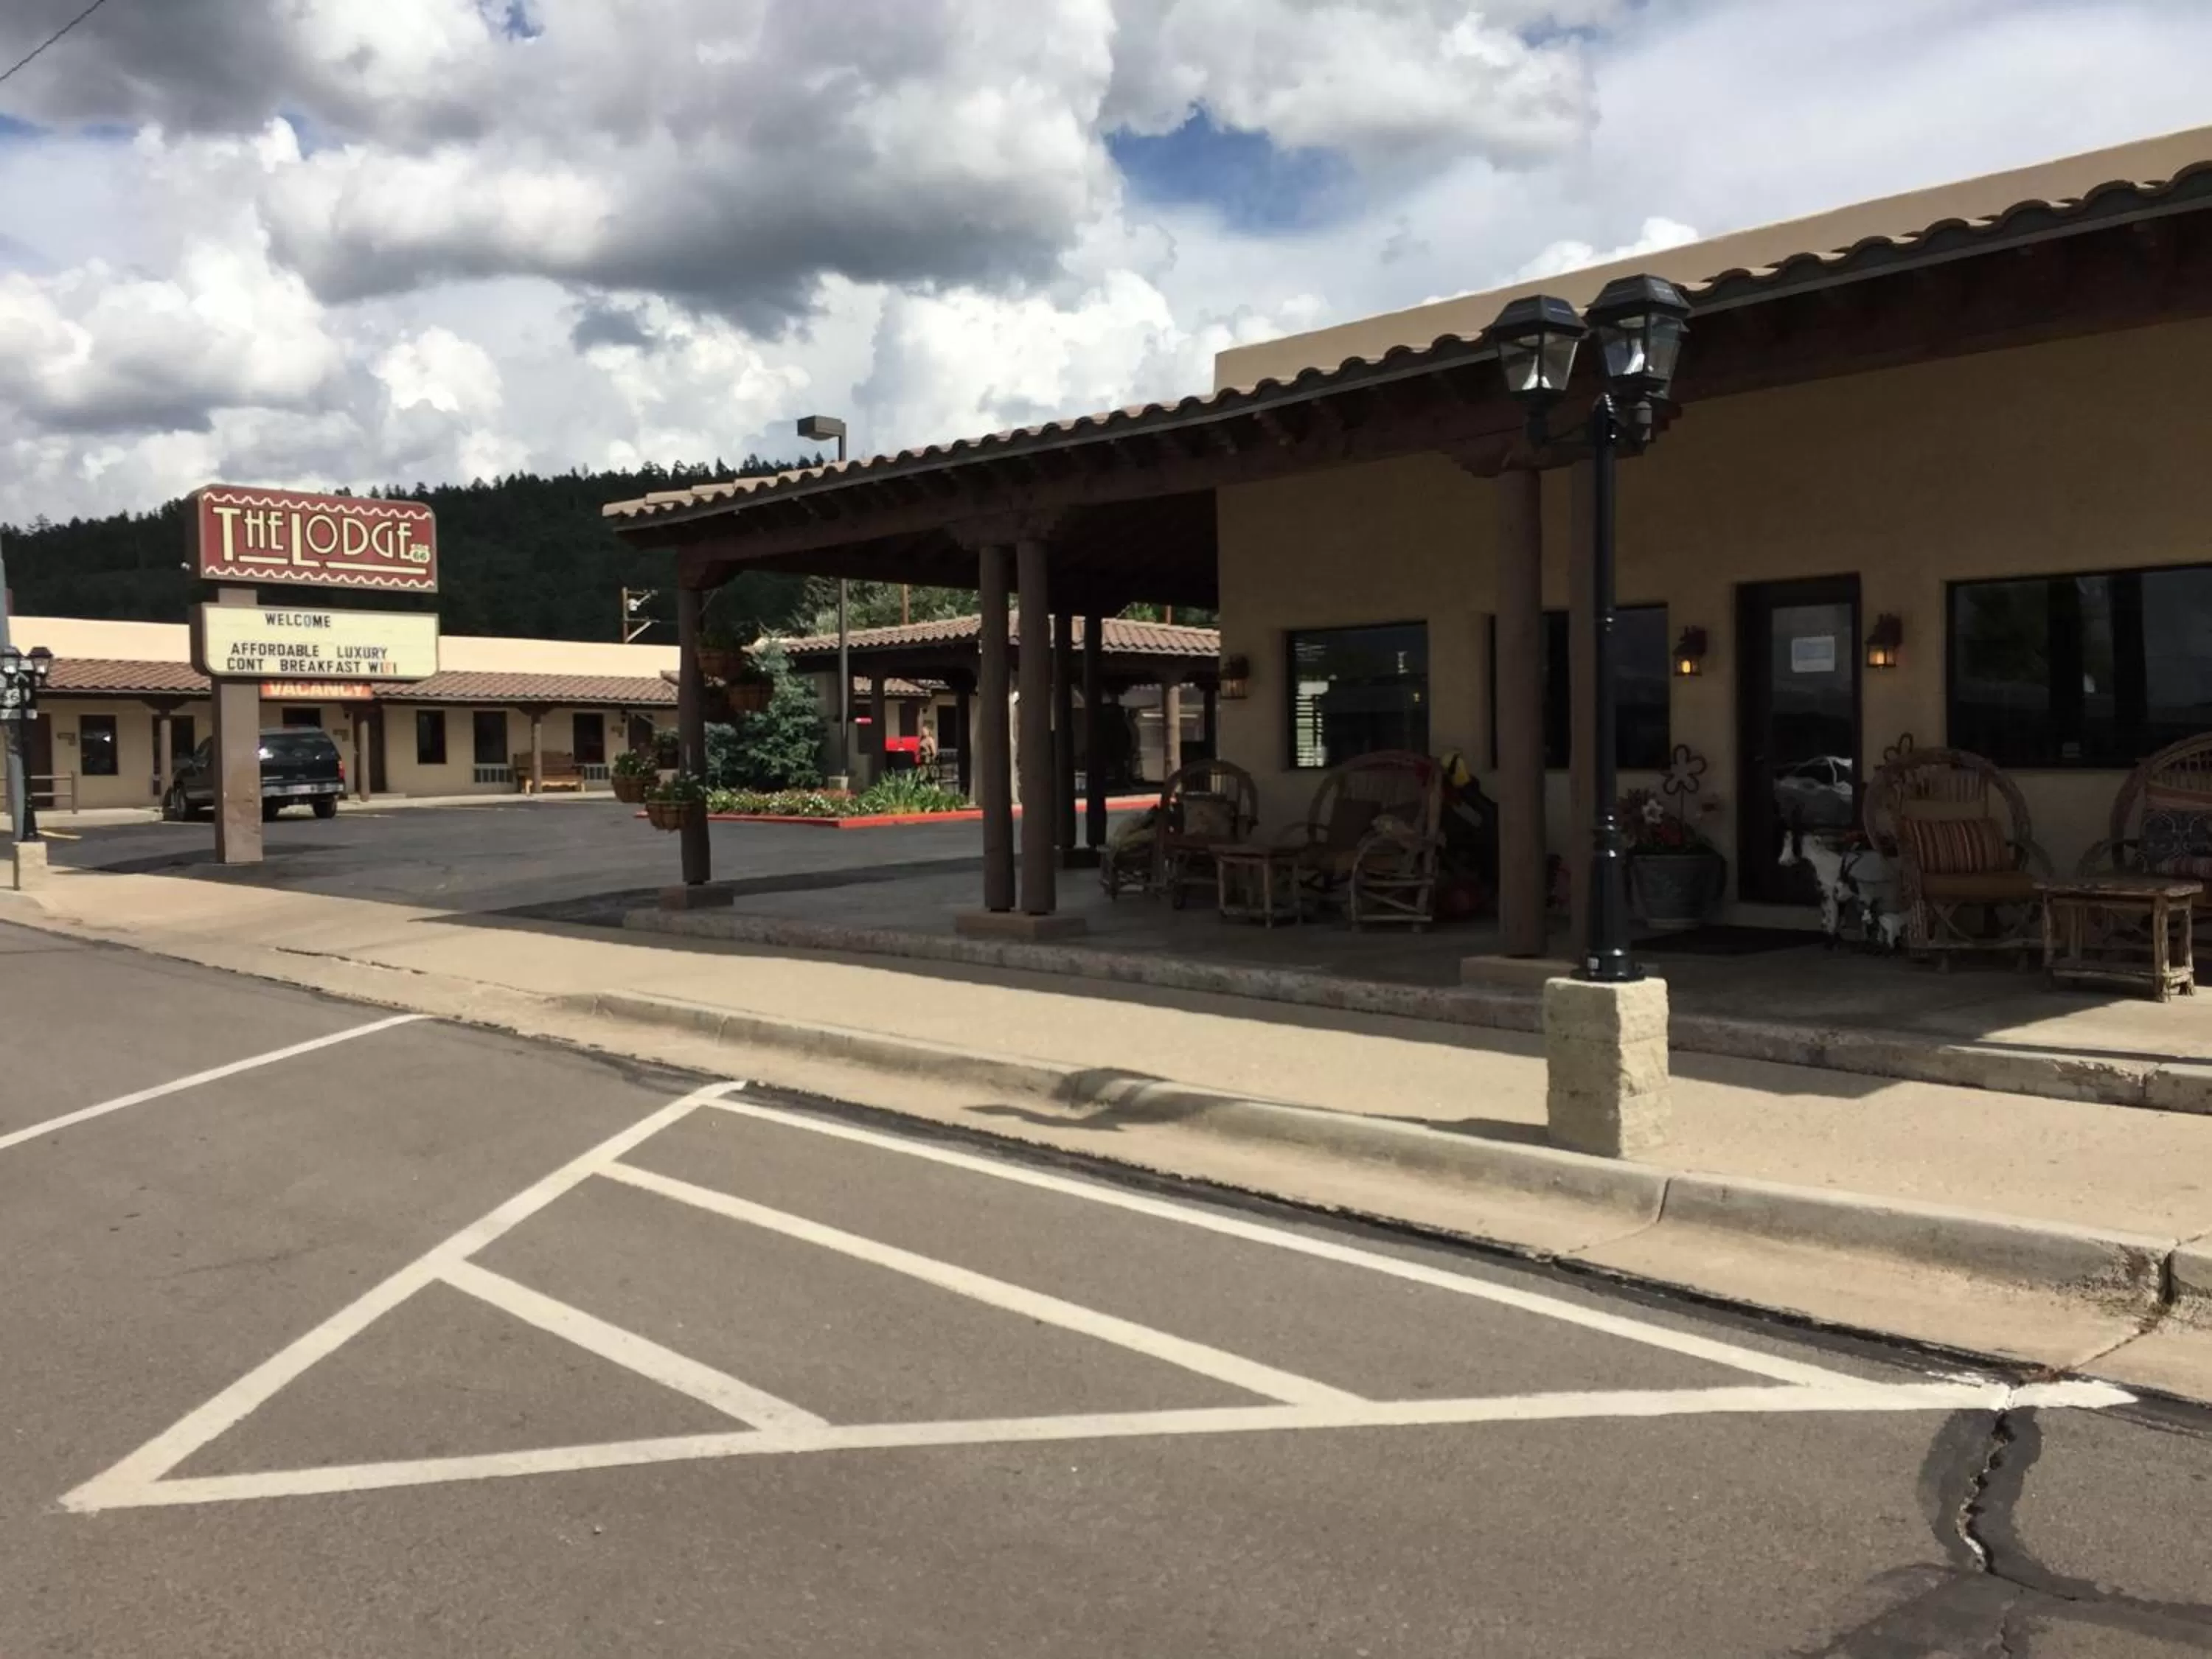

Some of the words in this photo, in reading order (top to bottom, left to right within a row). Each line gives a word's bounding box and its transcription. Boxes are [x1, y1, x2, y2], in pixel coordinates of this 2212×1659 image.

[213, 507, 285, 561] THE
[292, 512, 412, 567] LODGE
[265, 613, 331, 627] WELCOME
[231, 642, 319, 658] AFFORDABLE
[336, 647, 388, 659] LUXURY
[226, 658, 264, 671] CONT
[280, 658, 361, 672] BREAKFAST
[368, 661, 397, 674] WIFI
[270, 684, 365, 697] VACANCY
